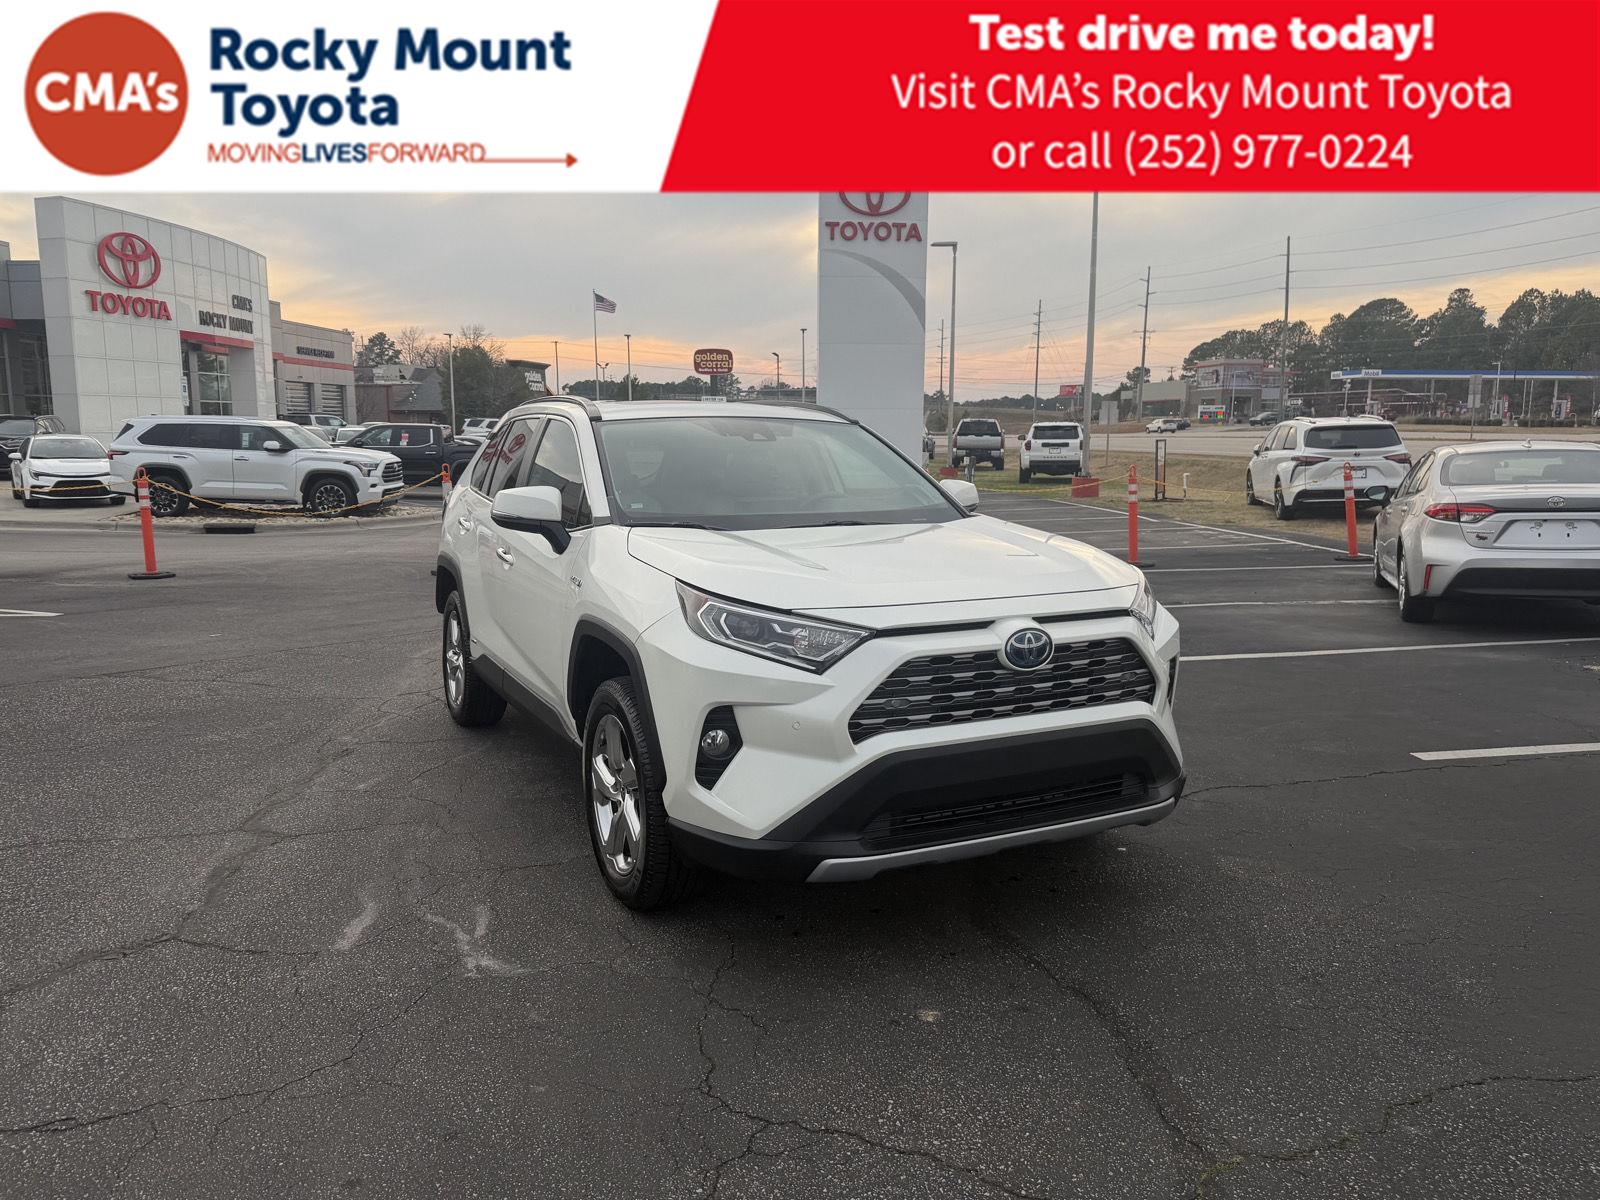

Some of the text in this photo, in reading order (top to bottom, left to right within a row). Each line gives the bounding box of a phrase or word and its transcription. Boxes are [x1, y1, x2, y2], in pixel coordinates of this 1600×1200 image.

[825, 221, 922, 242] TOYOTA
[85, 290, 172, 320] TOYOTA
[199, 311, 253, 334] ROCKY MOUNT
[695, 353, 729, 362] golden
[700, 360, 732, 368] corral
